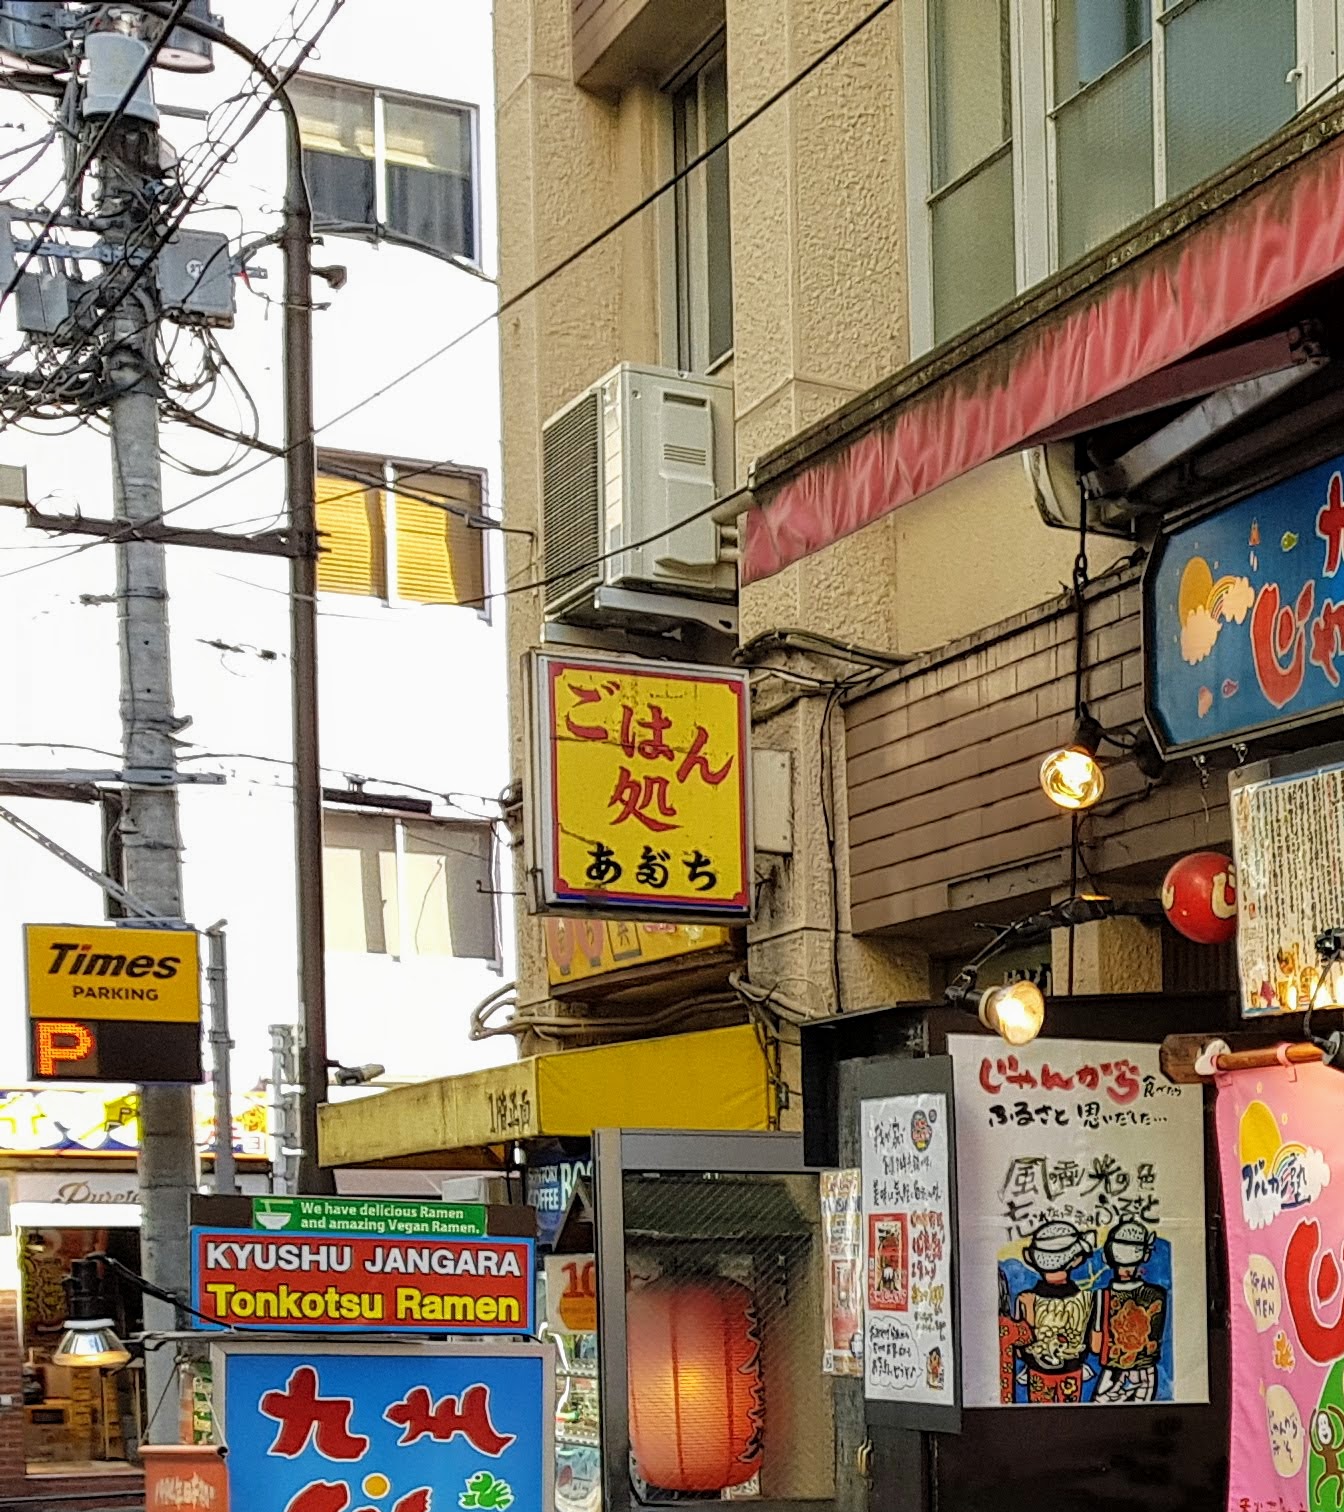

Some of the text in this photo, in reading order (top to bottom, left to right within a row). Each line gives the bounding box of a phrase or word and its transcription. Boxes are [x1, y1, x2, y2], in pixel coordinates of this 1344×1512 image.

[564, 684, 733, 786] ごはん
[608, 767, 681, 832] 処
[47, 942, 181, 980] Times
[72, 984, 159, 1003] PARKING
[36, 1022, 96, 1076] P
[979, 1055, 1140, 1104] じゃんがら
[988, 1103, 1069, 1127] ふるさと
[301, 1203, 464, 1219] We have delicious Ramen
[301, 1217, 480, 1234] and amazing Vegan Ramen.
[206, 1242, 521, 1277] KYUSHU JANGARA
[206, 1282, 520, 1321] Tonkotsu Ramen
[261, 1365, 515, 1460] 九州
